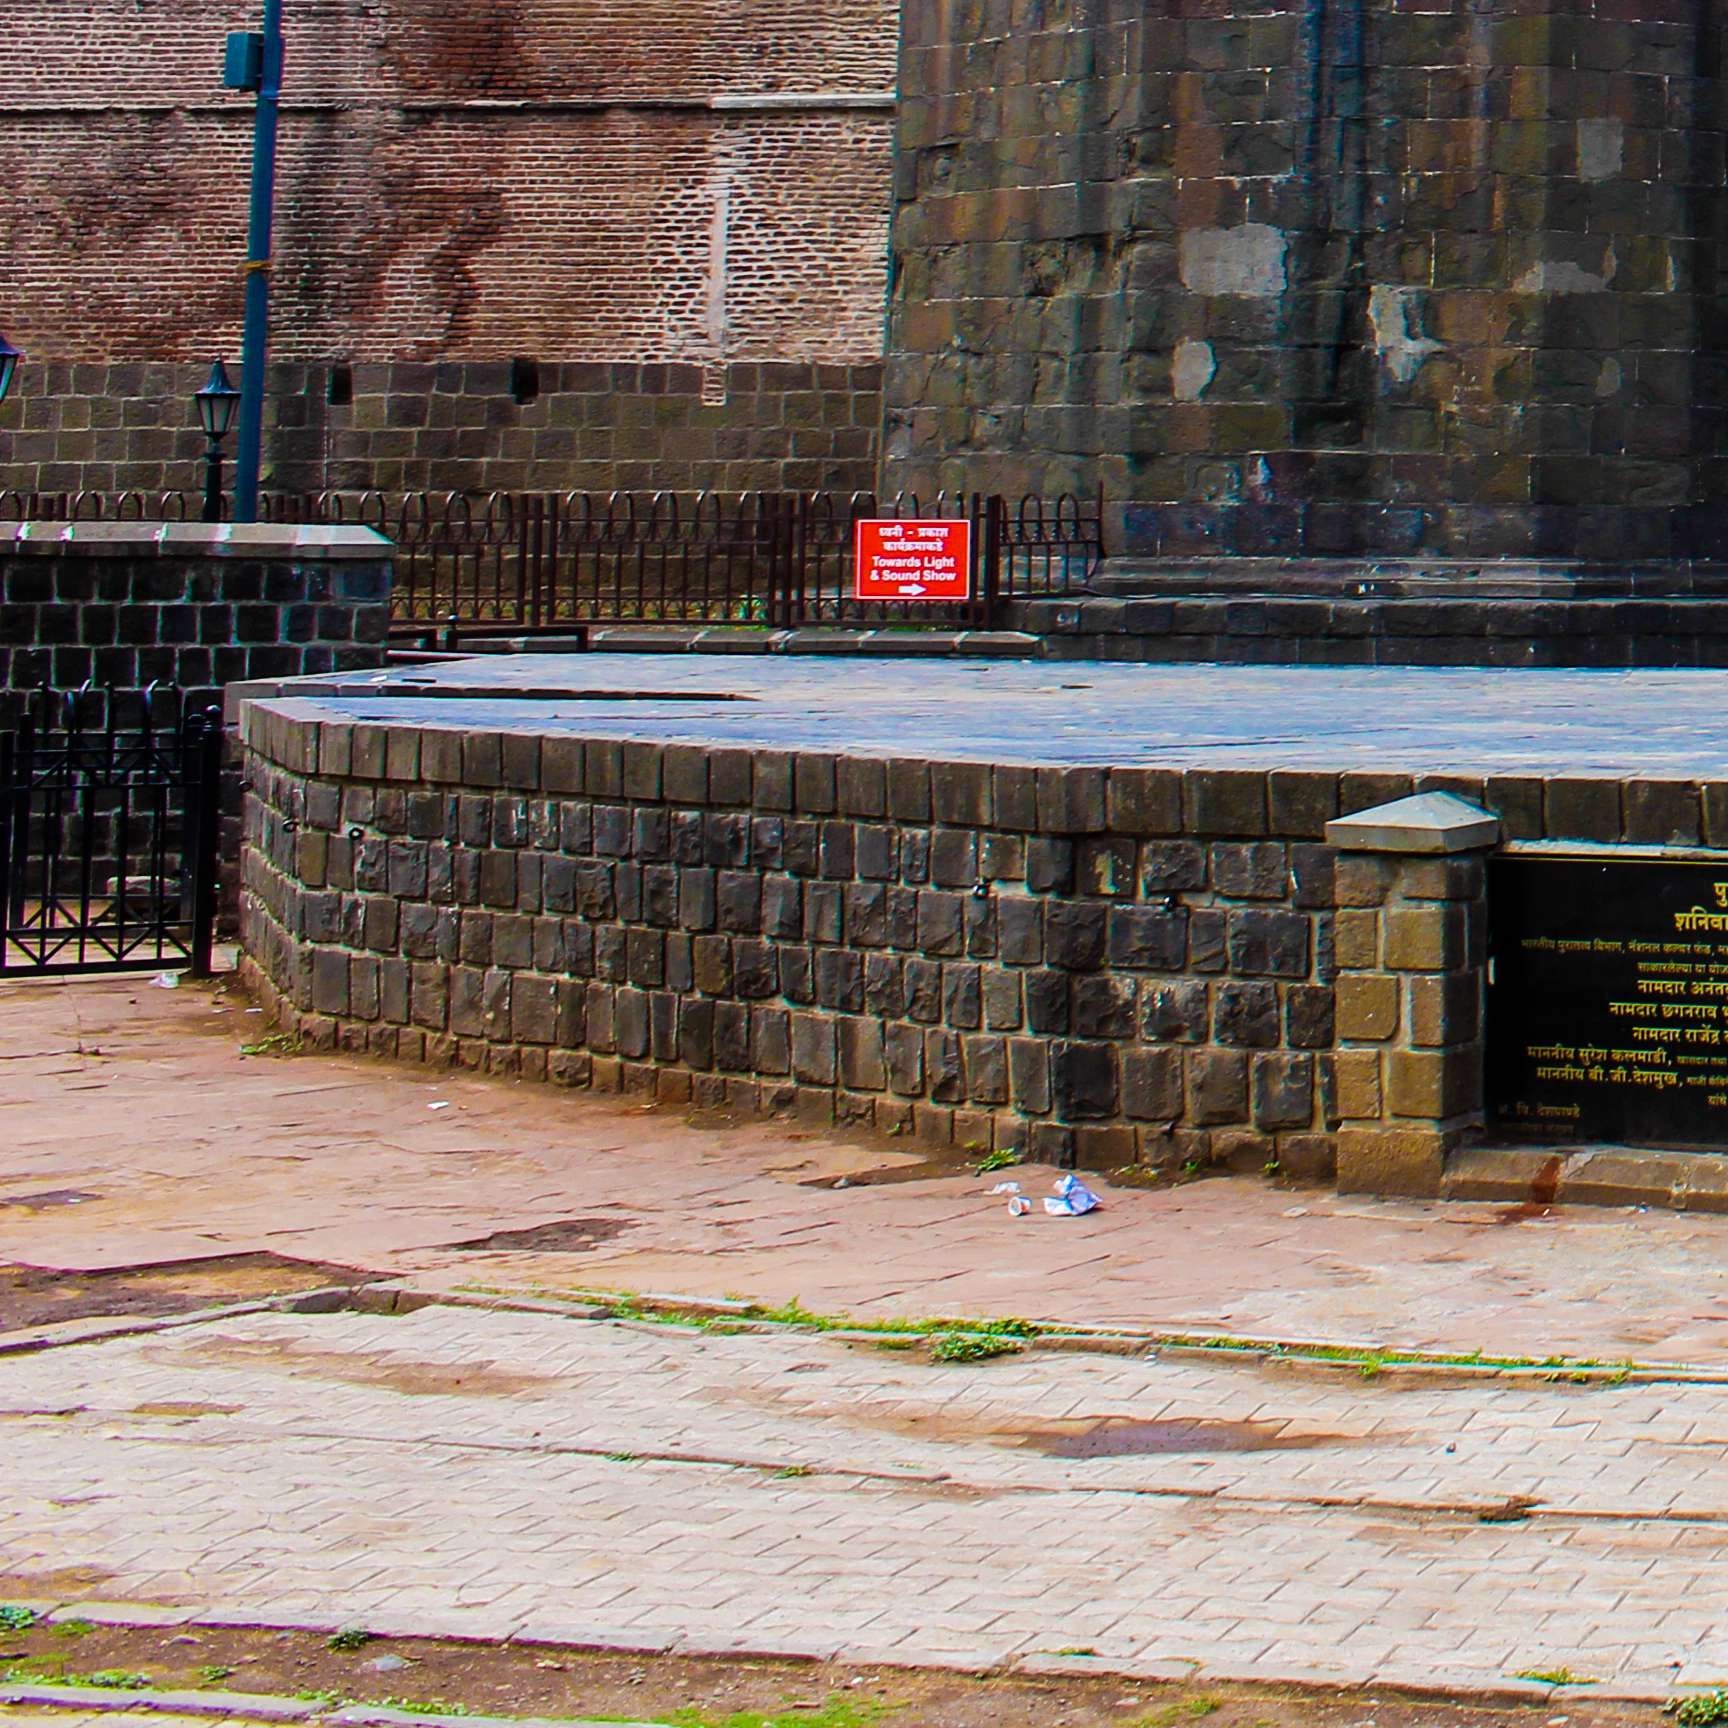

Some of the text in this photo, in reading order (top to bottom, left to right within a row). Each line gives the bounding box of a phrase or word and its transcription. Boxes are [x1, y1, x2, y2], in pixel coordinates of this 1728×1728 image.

[872, 556, 955, 569] Towards Light
[870, 570, 956, 581] & Sound Show
[1637, 980, 1686, 995] नामदार
[1609, 1002, 1657, 1017] नामदार
[1662, 1004, 1717, 1019] छगनराव
[1632, 1026, 1680, 1042] नामदार
[1528, 1043, 1574, 1059] माननीय
[1537, 1064, 1584, 1081] माननीय
